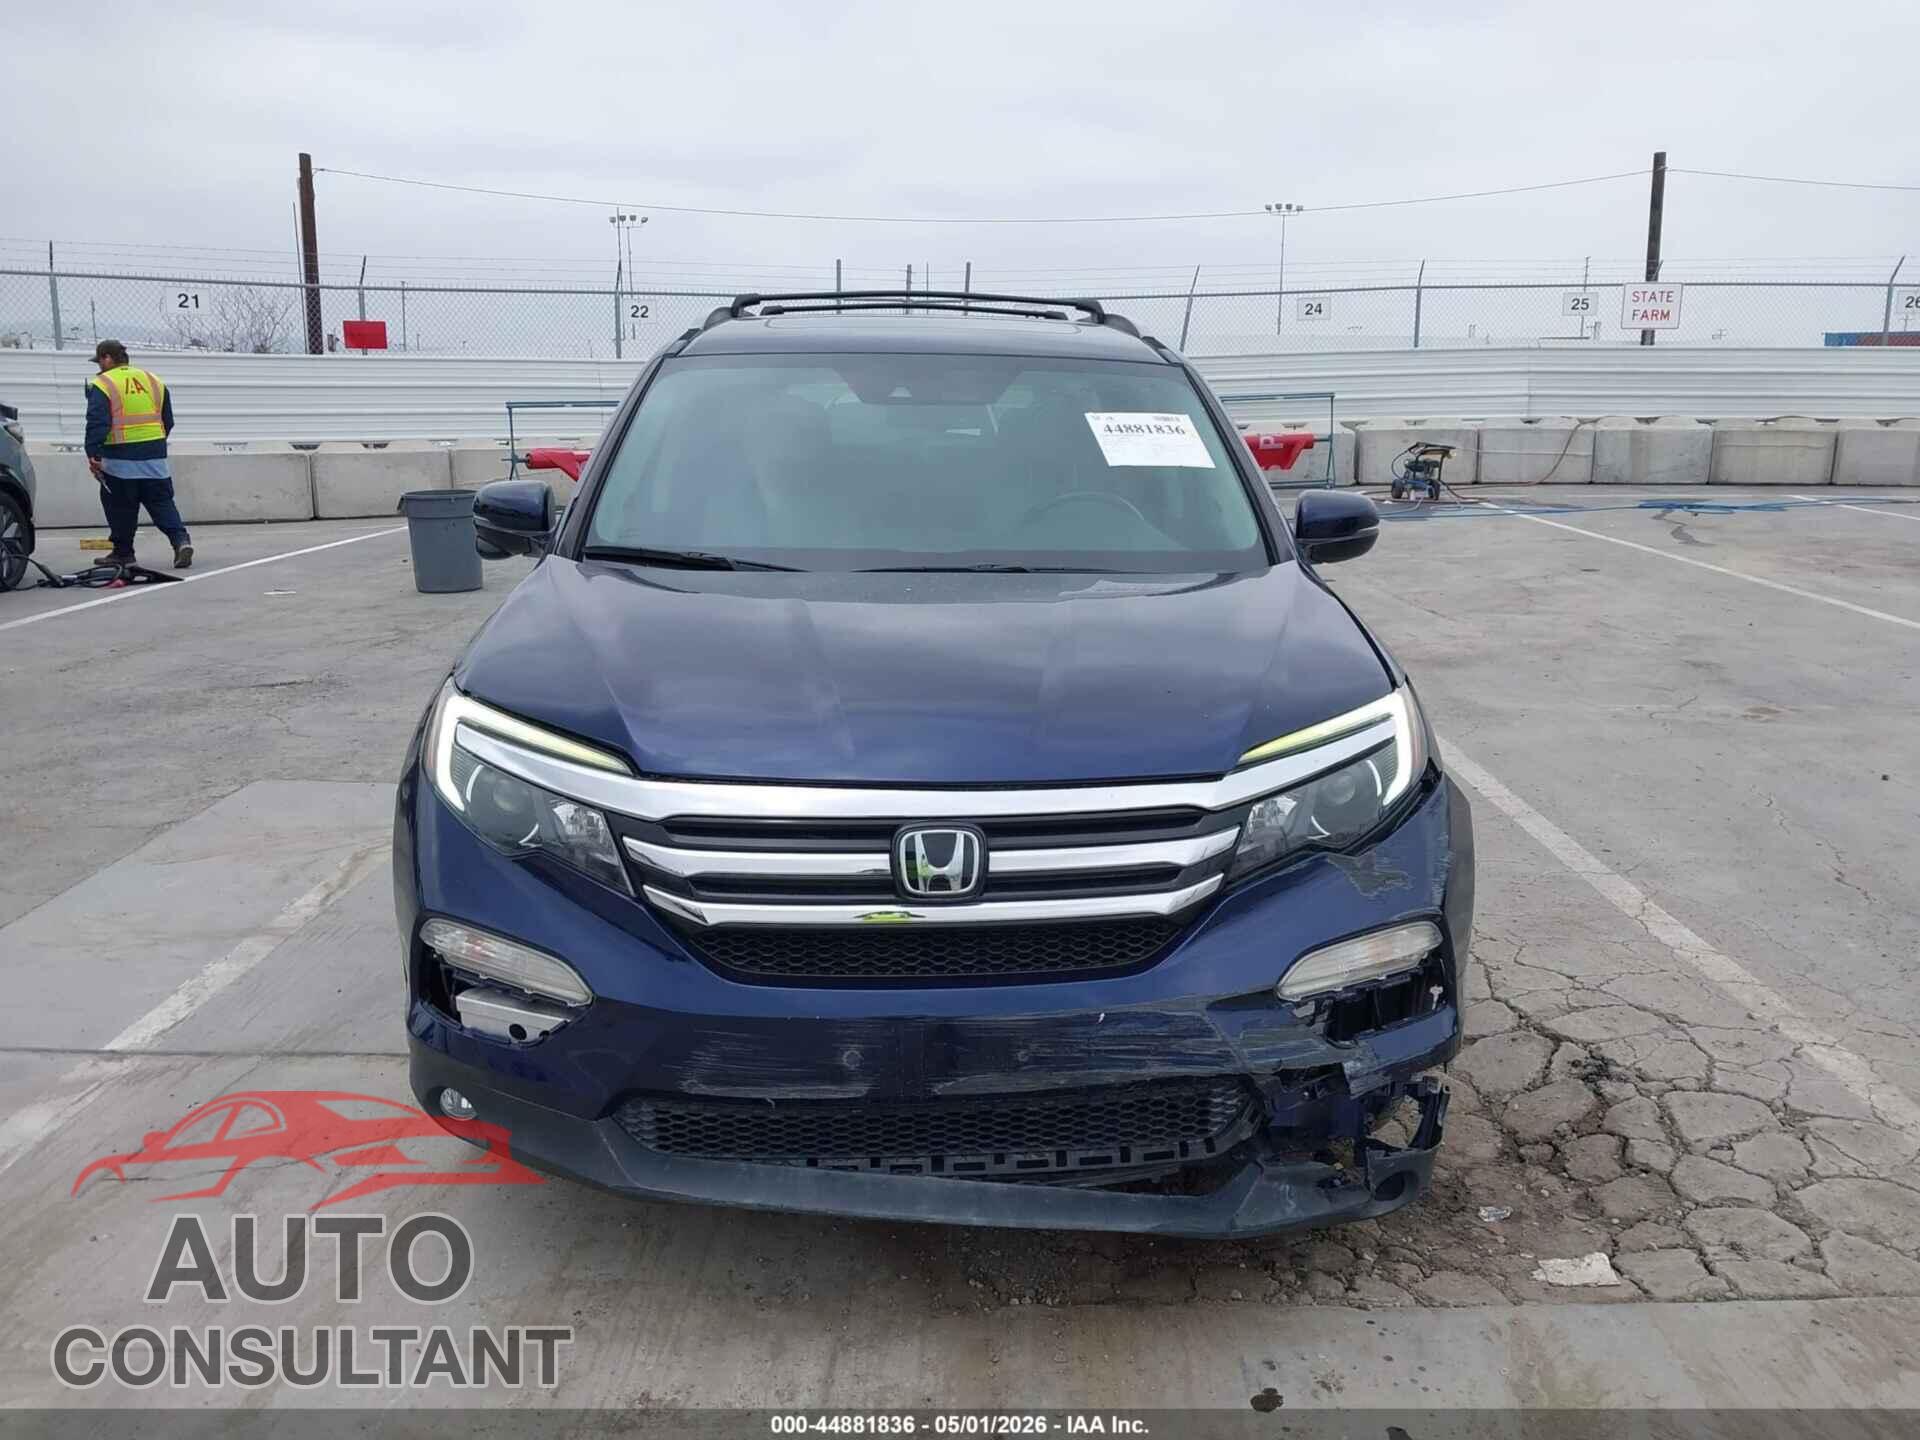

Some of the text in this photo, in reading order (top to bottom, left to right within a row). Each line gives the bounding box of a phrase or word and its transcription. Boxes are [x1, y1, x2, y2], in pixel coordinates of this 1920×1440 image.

[177, 293, 199, 309] 21
[1631, 290, 1675, 303] STATE
[1304, 303, 1322, 316] 24
[1571, 298, 1590, 311] 25
[630, 304, 649, 319] 22
[1631, 308, 1671, 321] FARM
[1103, 423, 1186, 435] 44881836
